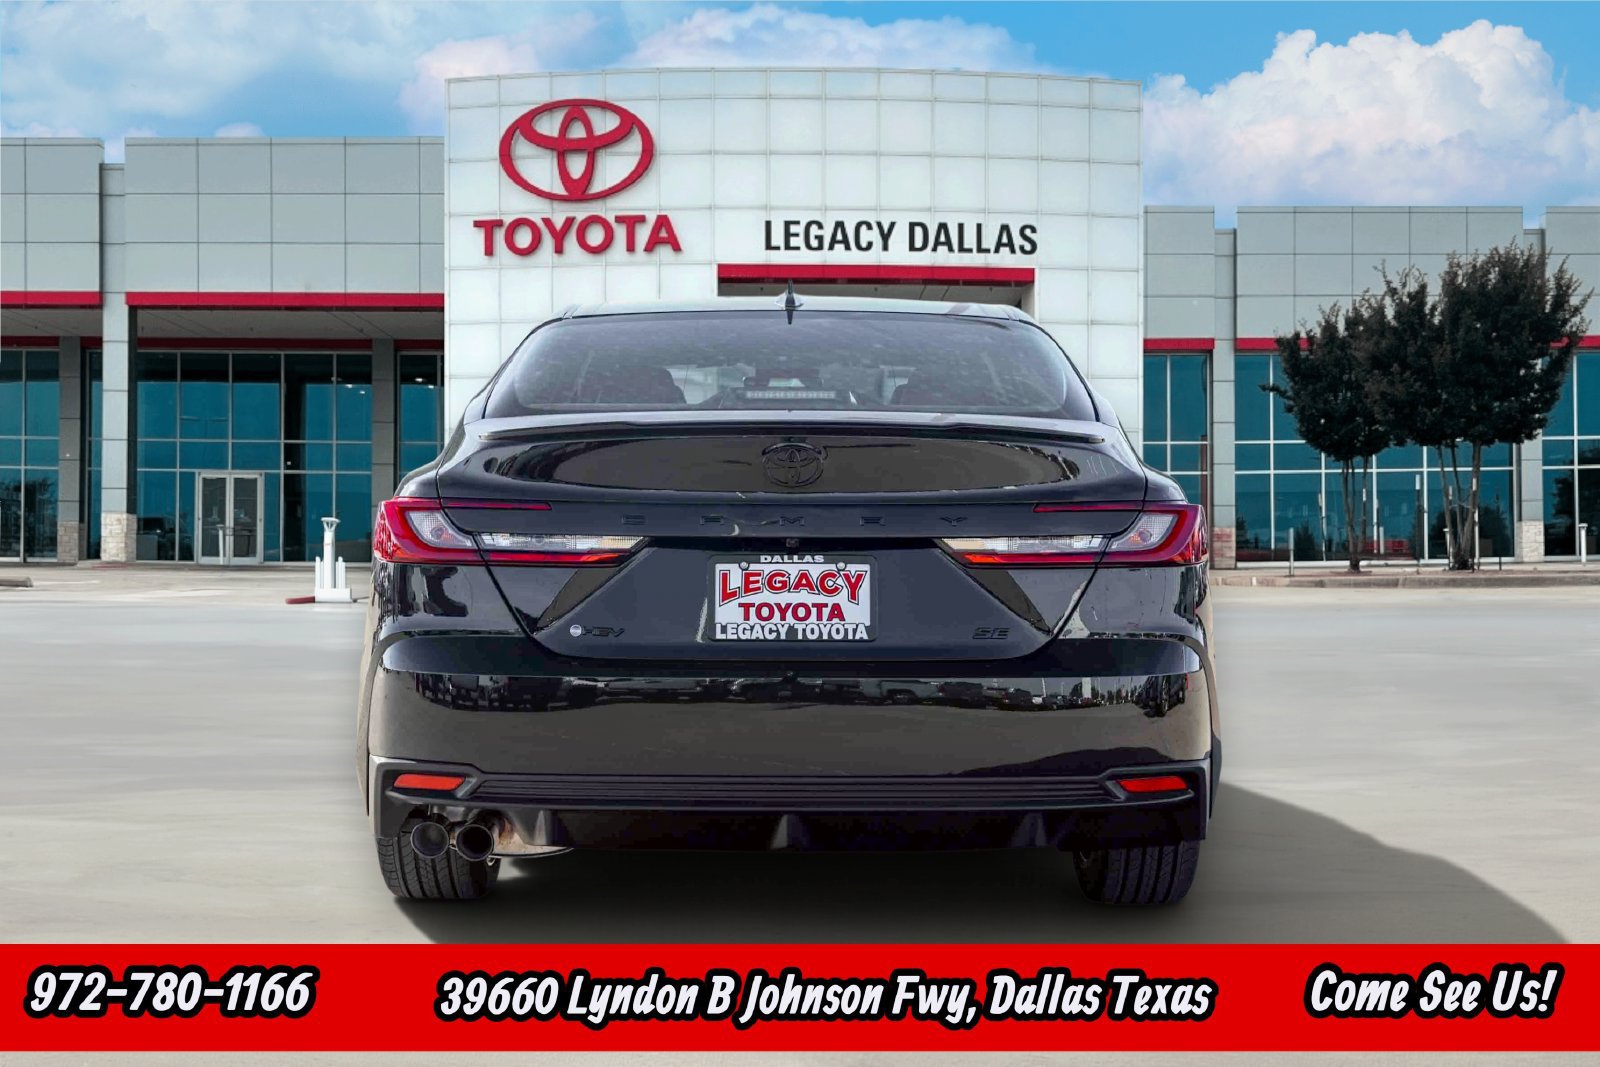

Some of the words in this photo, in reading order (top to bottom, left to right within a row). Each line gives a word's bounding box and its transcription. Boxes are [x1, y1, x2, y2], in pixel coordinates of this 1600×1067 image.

[473, 213, 682, 257] TOYOTA
[763, 219, 896, 253] LEGACY
[908, 221, 1039, 256] DALLAS
[759, 554, 825, 563] DALLAS
[719, 569, 868, 607] LEGACY
[738, 602, 845, 622] TOYOTA
[715, 623, 790, 640] LEGACY
[794, 623, 869, 640] TOYOTA
[972, 627, 1009, 640] SE
